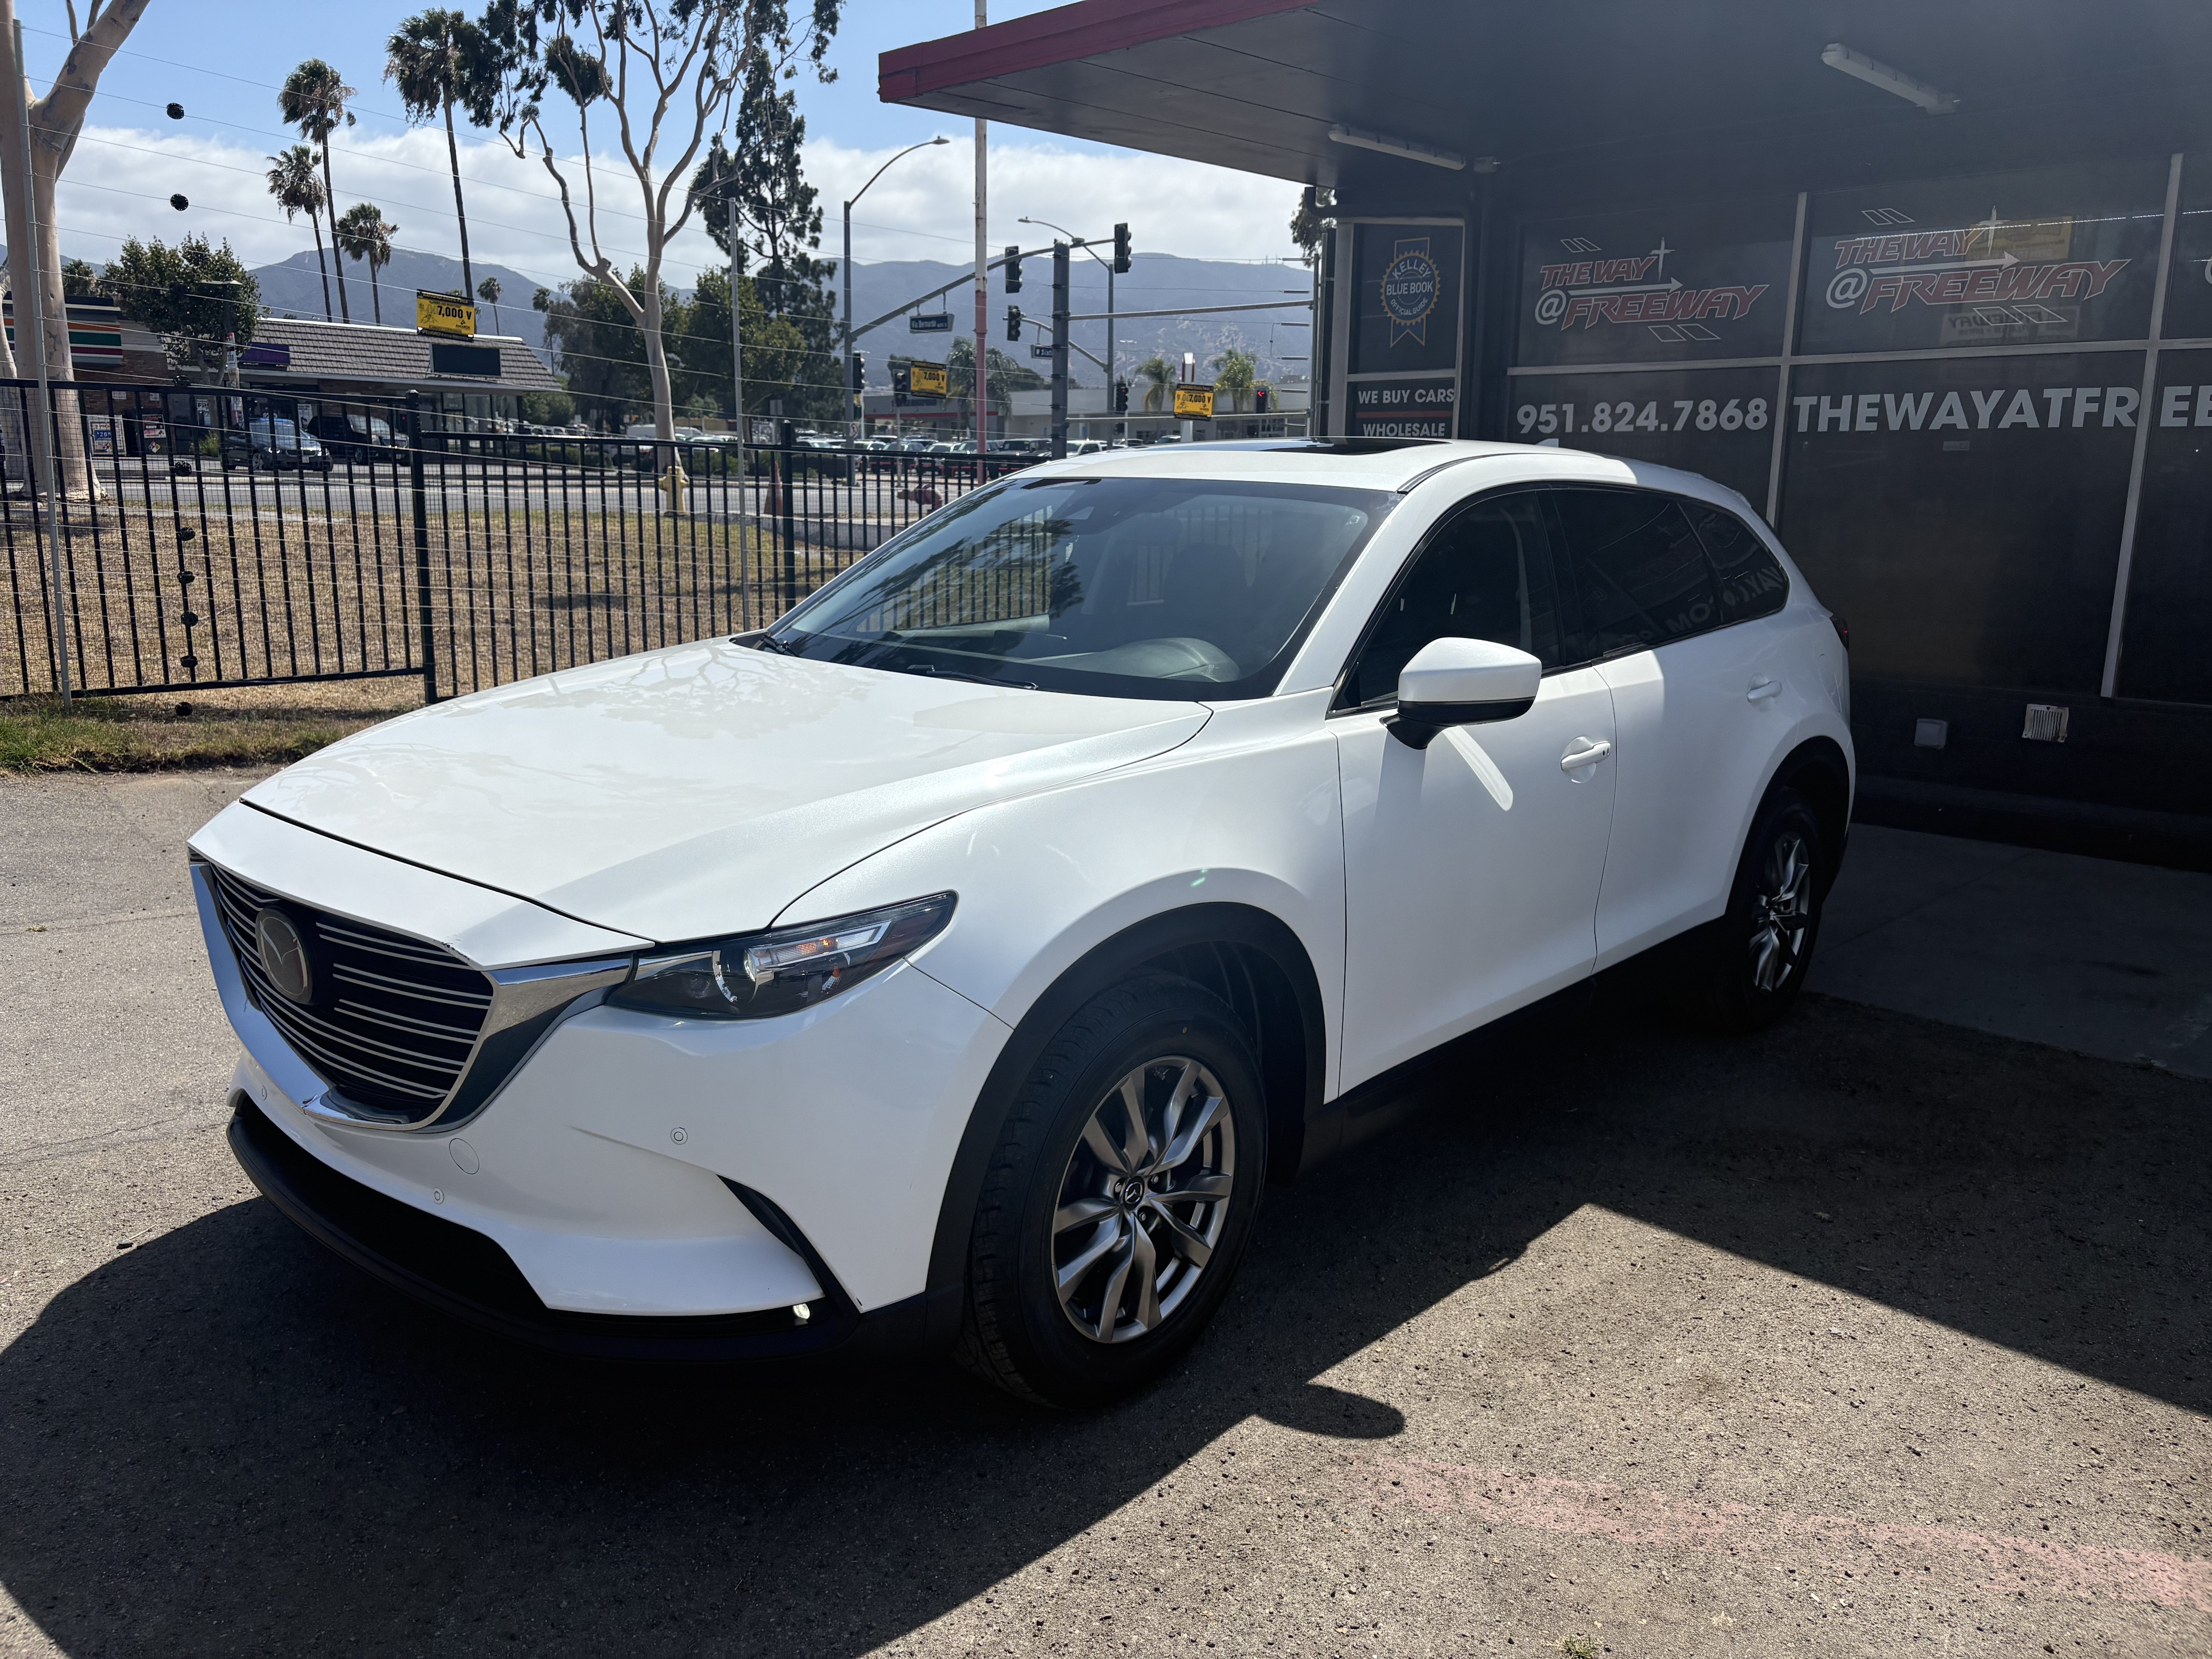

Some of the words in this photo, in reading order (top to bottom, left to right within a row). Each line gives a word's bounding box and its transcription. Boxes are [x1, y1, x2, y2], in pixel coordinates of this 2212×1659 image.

[1834, 235, 1904, 270] THE
[1902, 229, 1986, 259] WAY
[1393, 259, 1431, 279] KELLEY
[1540, 262, 1593, 290] THE
[1594, 256, 1658, 283] WAY
[1386, 283, 1408, 295] BLUE
[1410, 281, 1433, 294] BOOK
[437, 305, 463, 319] 7,000
[466, 311, 472, 320] V
[1391, 299, 1412, 315] OFFICIAL
[1413, 297, 1428, 314] GUIDE
[924, 372, 939, 381] 7,000
[1358, 390, 1378, 404] WE
[1382, 390, 1410, 403] BUY
[1415, 388, 1455, 403] CARS
[1516, 398, 1767, 433] 951.824.7868
[1363, 423, 1446, 436] WHOLESALE
